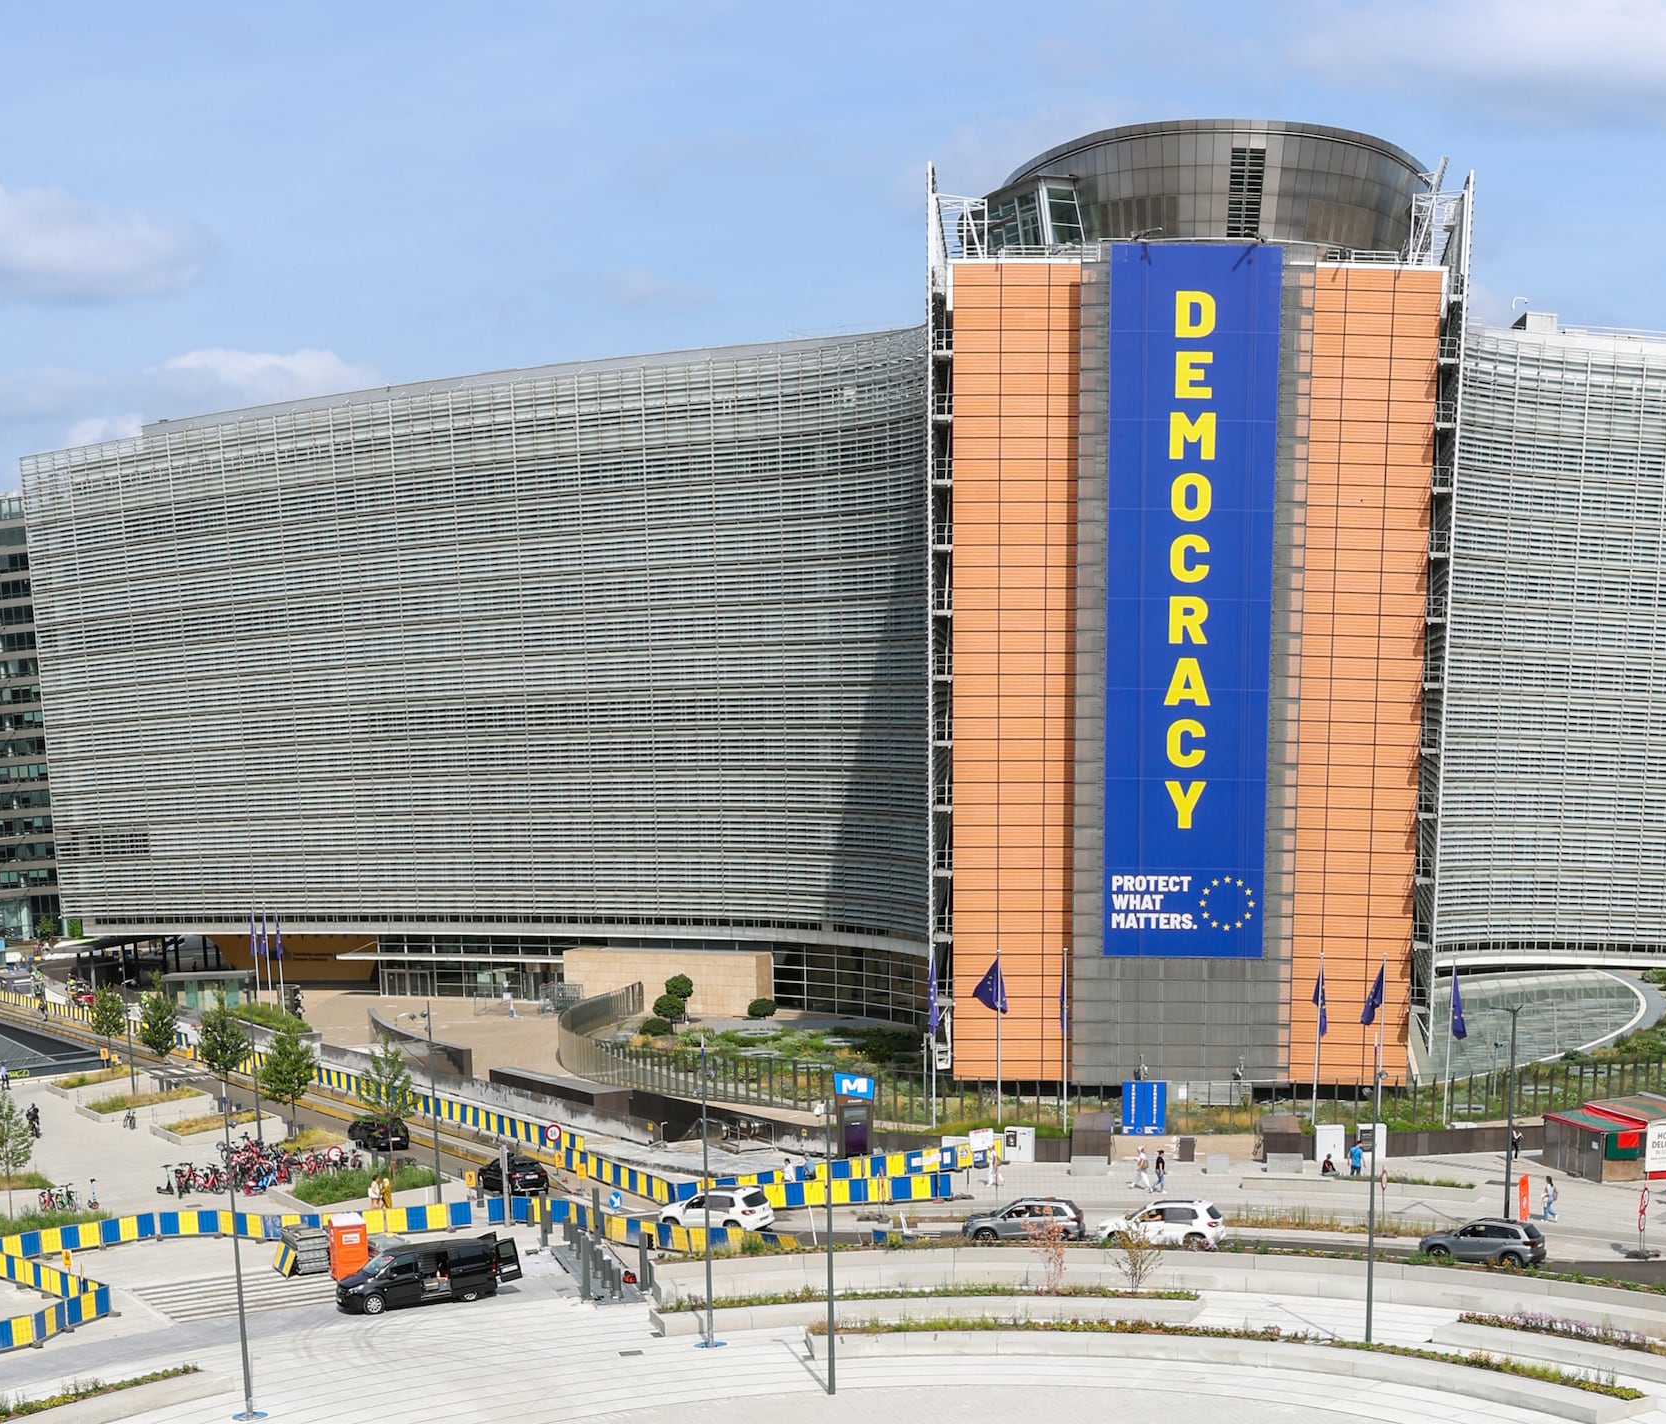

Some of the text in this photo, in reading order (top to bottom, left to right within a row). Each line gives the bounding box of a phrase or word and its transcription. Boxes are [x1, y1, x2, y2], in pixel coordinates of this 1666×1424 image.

[1164, 290, 1218, 830] DEMOCRACY
[1111, 875, 1192, 893] PROTECT
[1111, 894, 1163, 911] WHAT
[1110, 912, 1199, 931] MATTERS.
[842, 1077, 867, 1094] M
